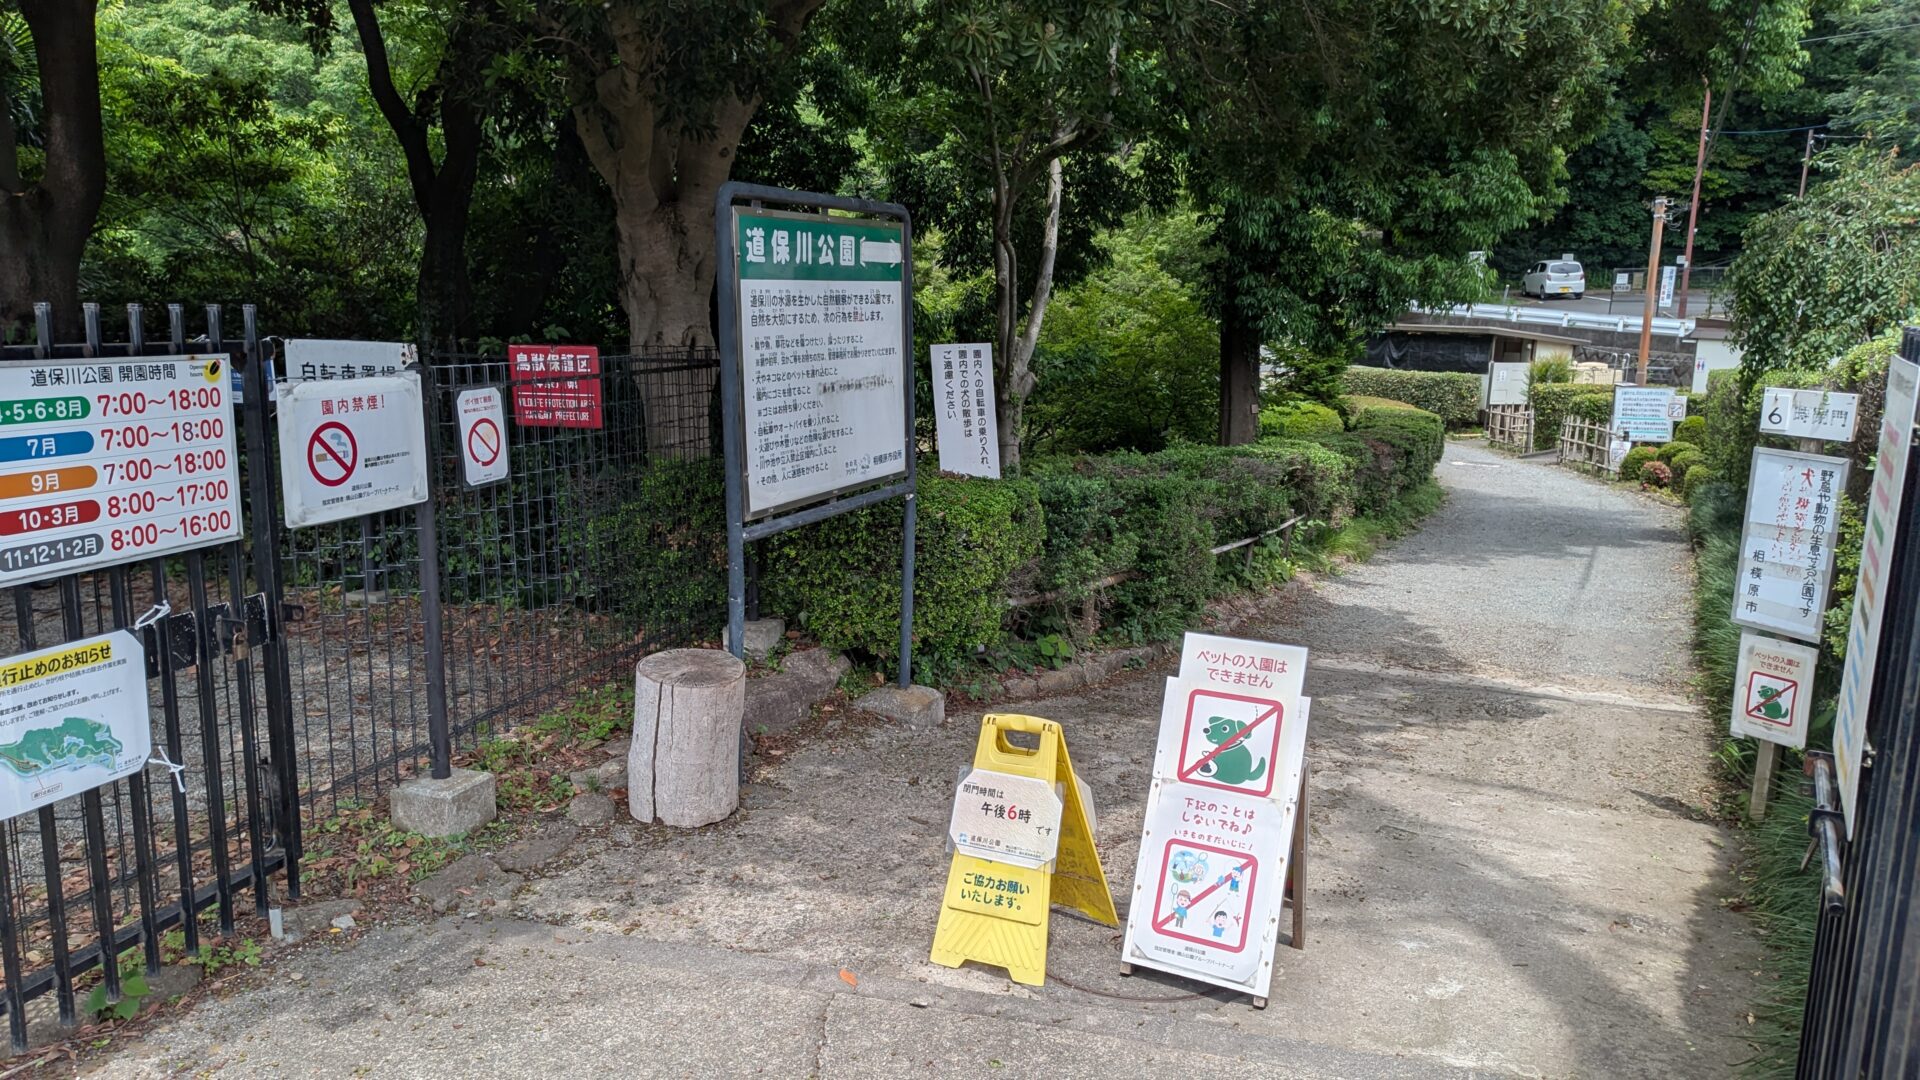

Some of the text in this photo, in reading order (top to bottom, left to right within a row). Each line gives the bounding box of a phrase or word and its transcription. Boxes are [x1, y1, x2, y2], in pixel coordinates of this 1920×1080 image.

[746, 226, 857, 266] 道保川公園
[516, 352, 591, 373] 鳥獣保護区
[30, 363, 176, 387] 道保川公園 開園時間
[958, 349, 973, 438] 園内での犬の散歩は
[0, 399, 82, 423] ・5・6・8月
[972, 349, 991, 470] 園内への自転車の乗り入れ、
[26, 437, 56, 457] 7月
[31, 473, 60, 492] 9月
[18, 506, 79, 530] 10・3月
[1799, 469, 1834, 618] 野鳥や動物の生息する公園です
[1745, 548, 1766, 614] 相模原市
[0, 644, 112, 688] 行止めのお知らせ
[1196, 649, 1288, 674] ペットの入園は
[1754, 651, 1801, 668] ペットの入園は
[1759, 660, 1794, 675] できません
[1206, 667, 1273, 689] できません
[981, 801, 1032, 824] 午後6時
[1184, 796, 1256, 821] 下記のことは
[1036, 825, 1053, 837] です
[963, 871, 1030, 895] ご協力お願い
[960, 889, 1022, 911] いたします。
